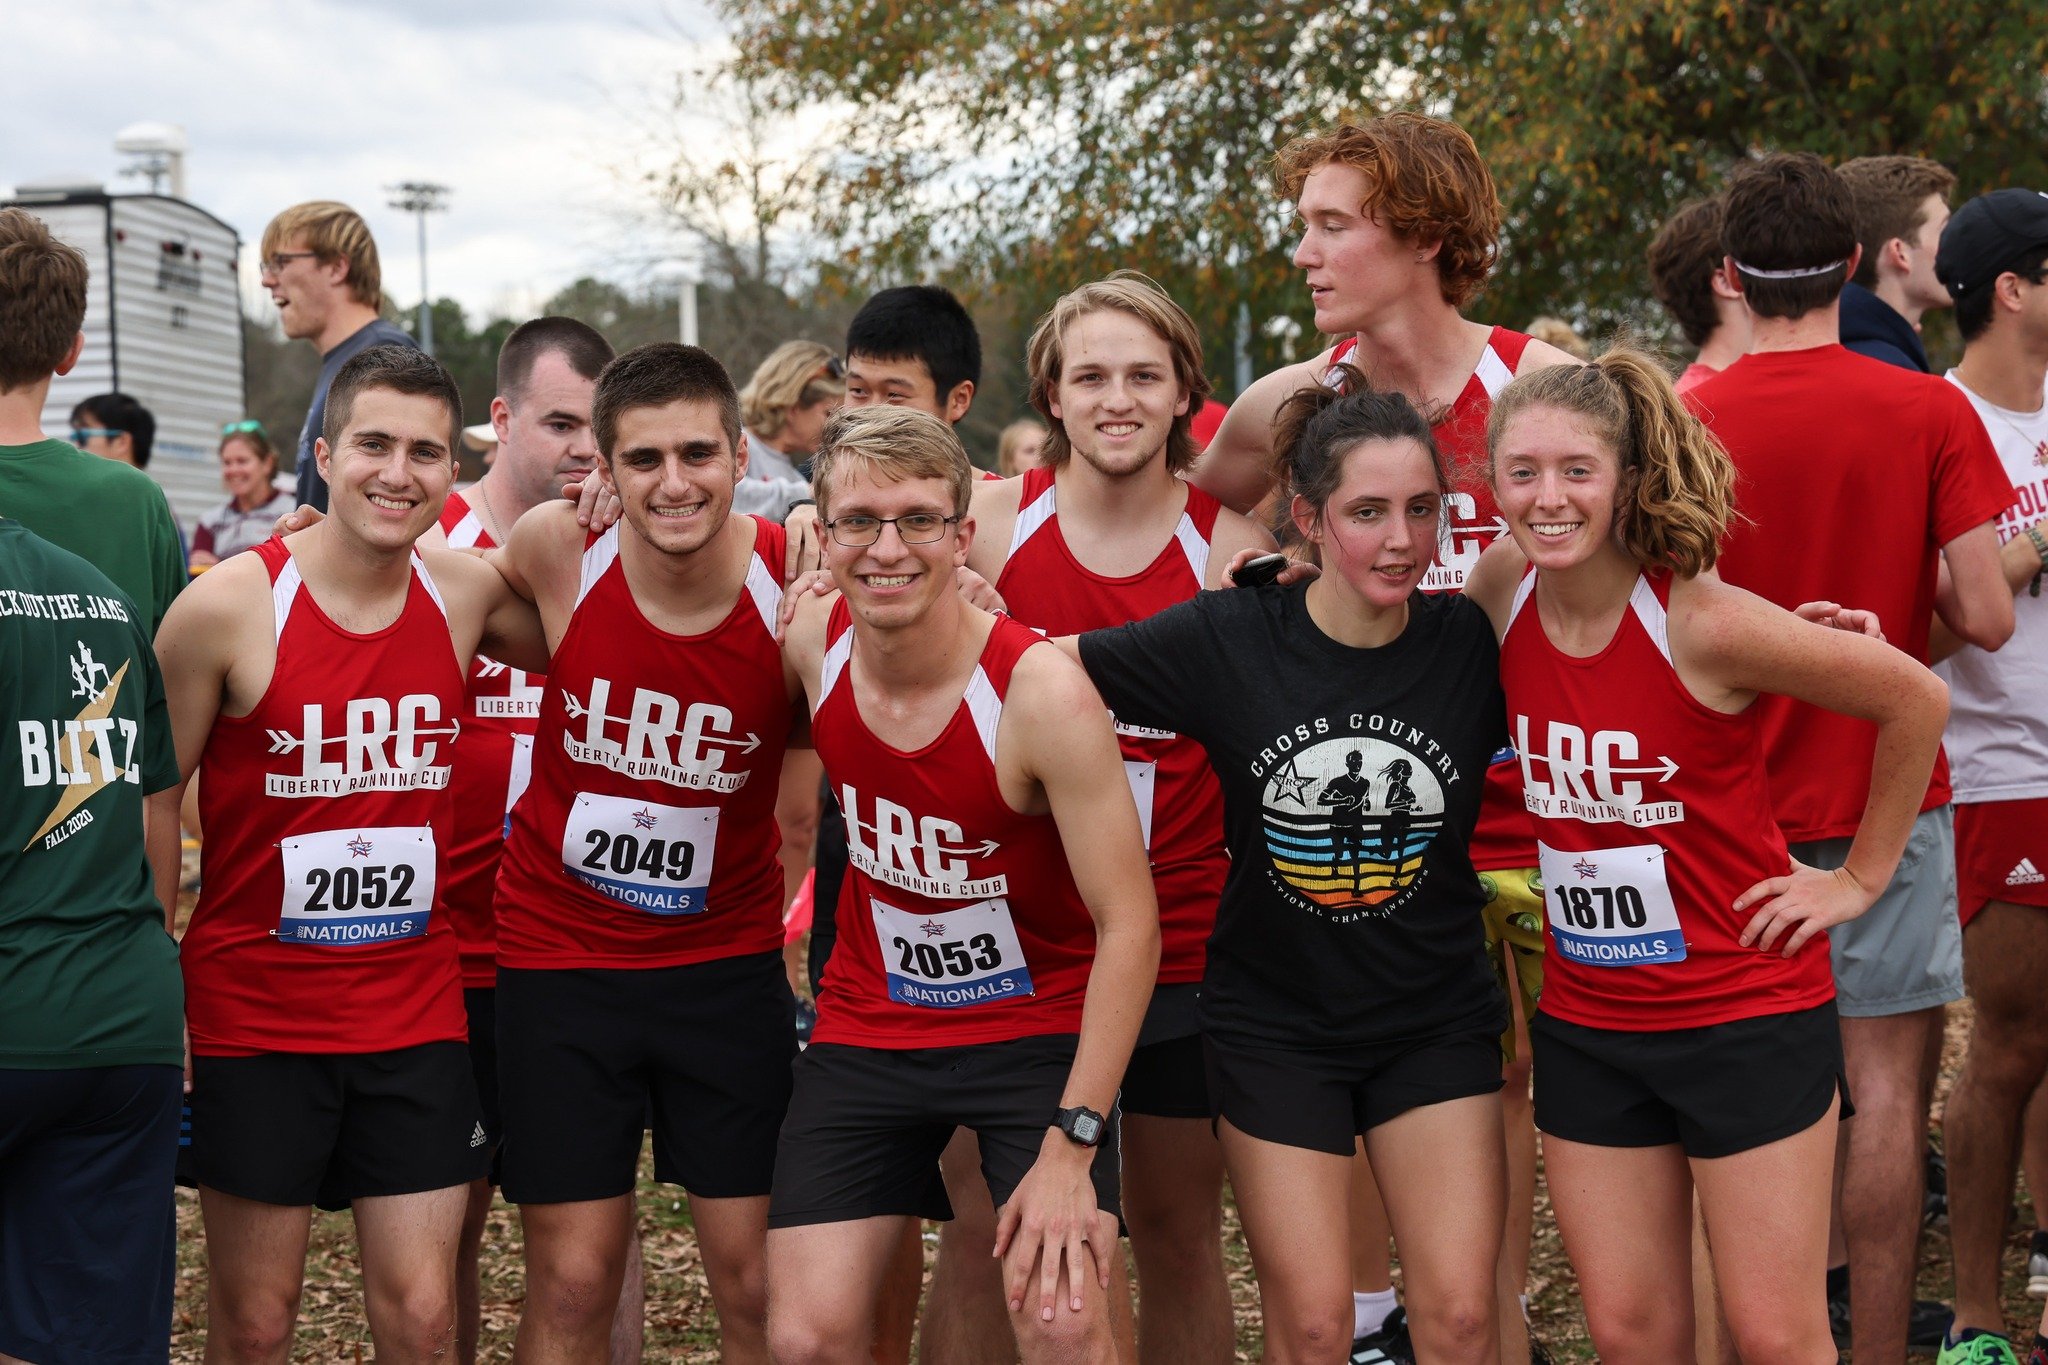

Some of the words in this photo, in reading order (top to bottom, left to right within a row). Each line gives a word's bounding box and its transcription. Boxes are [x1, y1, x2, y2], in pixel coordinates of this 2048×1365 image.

[0, 590, 23, 616] CK
[19, 591, 50, 619] OUT
[46, 594, 85, 621] THE
[86, 595, 129, 623] JAMS
[303, 694, 441, 776] LRC
[587, 677, 732, 772] LRC
[18, 717, 140, 787] BLITZ
[564, 737, 620, 768] LIBERTY
[627, 761, 699, 786] RUNNING
[707, 774, 746, 790] CLUB
[1250, 717, 1330, 778] CROSS
[1349, 713, 1460, 785] COUNTRY
[1517, 714, 1643, 806] LRC
[271, 778, 341, 794] LIBERTY
[349, 772, 417, 791] RUNNING
[45, 825, 69, 850] FALL
[66, 808, 95, 835] 2020
[842, 783, 968, 881] LRC
[1560, 799, 1625, 821] RUNNING
[1633, 805, 1678, 823] CLUB
[582, 829, 695, 881] 2049
[304, 864, 415, 911] 2052
[585, 876, 690, 909] NATIONALS
[883, 868, 951, 894] RUNNING
[960, 880, 1002, 895] CLUB
[1266, 869, 1323, 917] NATIONAL
[304, 920, 413, 940] NATIONALS
[1554, 884, 1647, 930] 1870
[893, 933, 1002, 979] 2053
[1566, 939, 1668, 961] NATIONALS
[909, 978, 1015, 1004] NATIONALS
